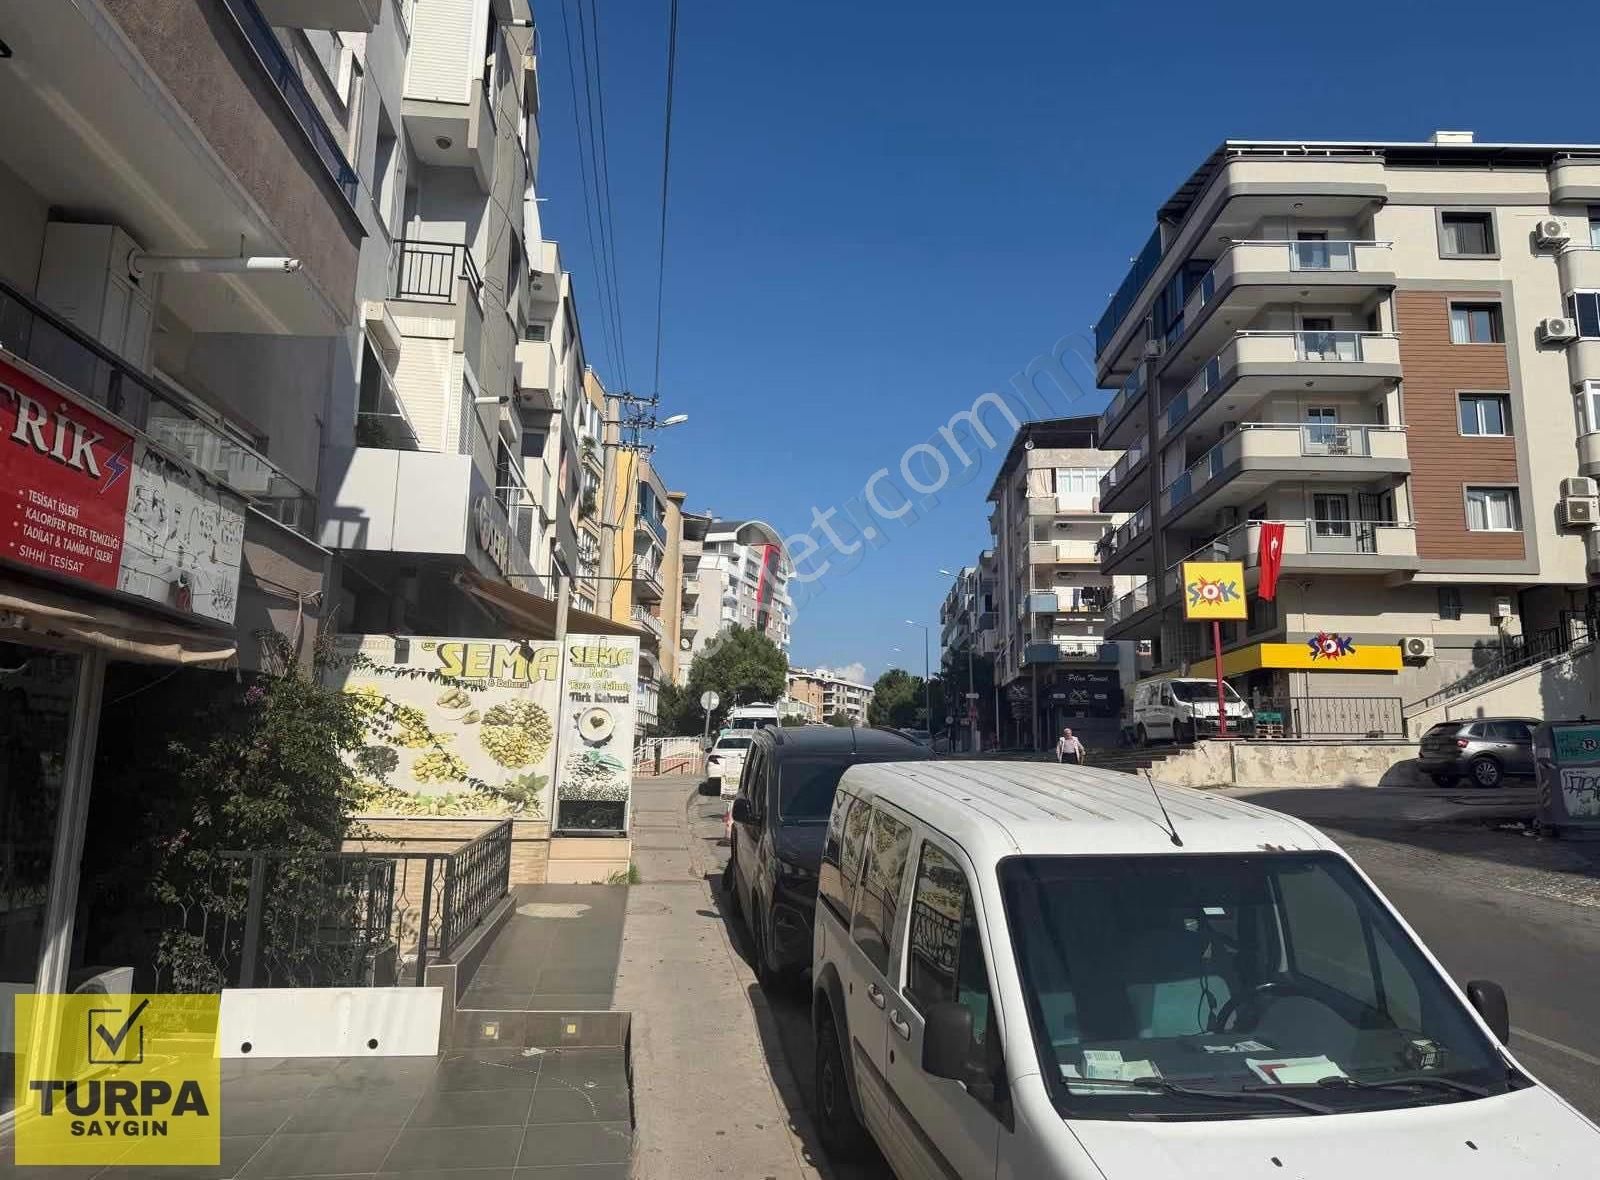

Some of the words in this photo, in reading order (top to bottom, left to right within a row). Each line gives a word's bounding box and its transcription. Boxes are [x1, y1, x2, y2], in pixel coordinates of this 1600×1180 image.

[28, 489, 57, 512] TESİSAT
[25, 507, 66, 532] KALORİFER
[67, 522, 88, 538] PETEK
[23, 523, 54, 545] TADİLAT
[54, 535, 61, 548] &
[62, 537, 93, 557] TAMİRAT
[48, 553, 85, 573] TESİSAT
[437, 643, 559, 683] SEMA
[569, 646, 633, 665] SEMA
